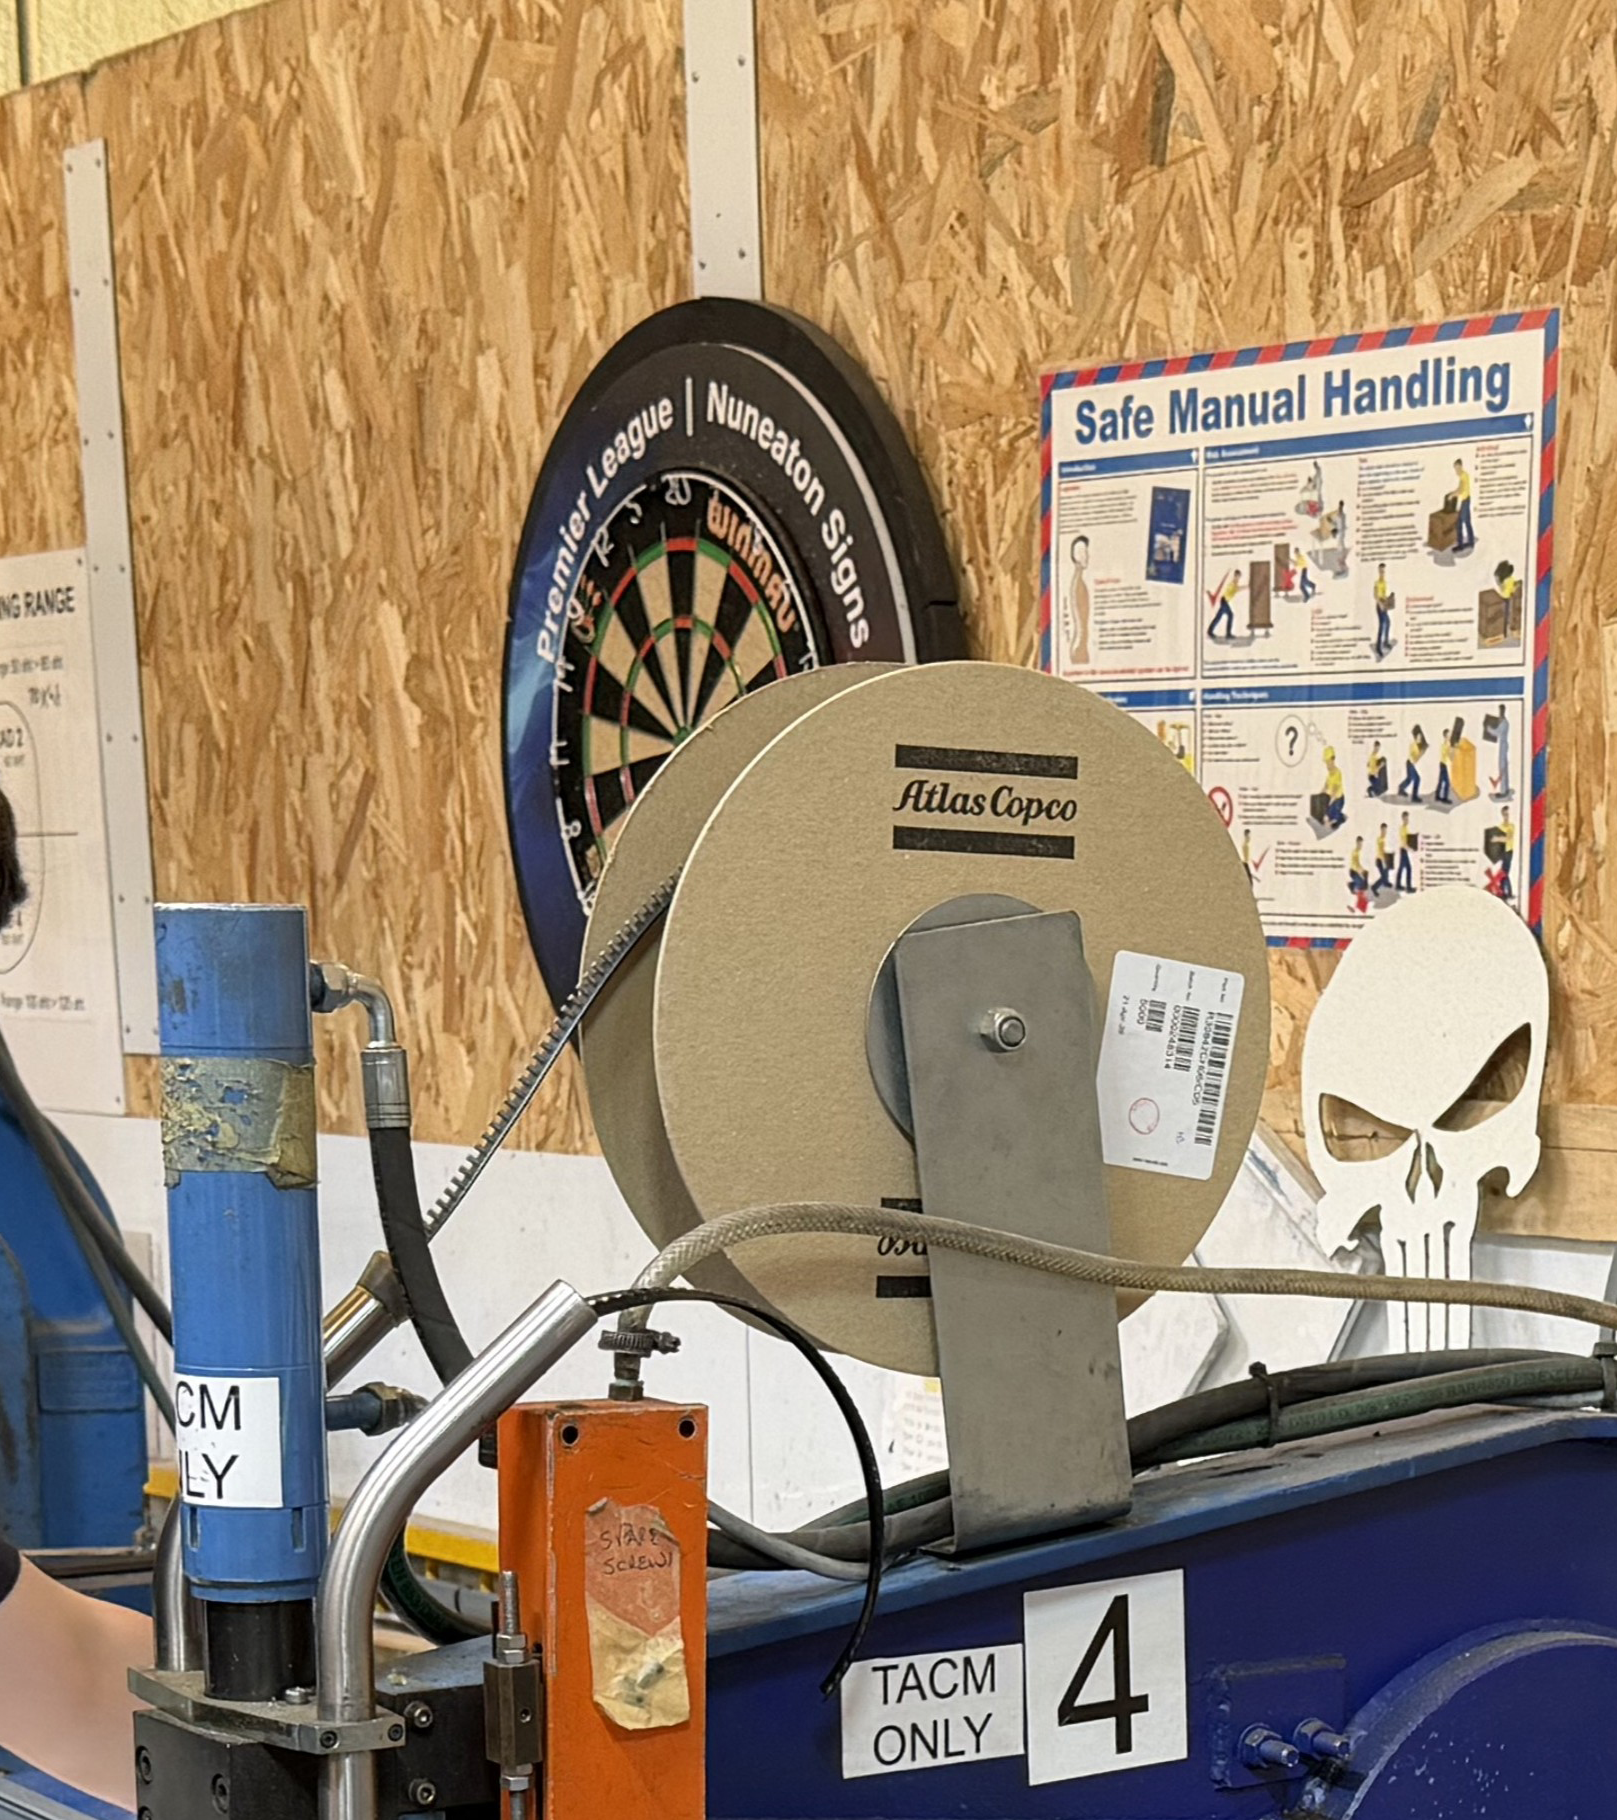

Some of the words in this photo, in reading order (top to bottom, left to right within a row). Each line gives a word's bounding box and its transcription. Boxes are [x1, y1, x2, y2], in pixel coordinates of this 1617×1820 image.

[1074, 395, 1155, 446] Safe
[1167, 374, 1307, 434] Manual
[1323, 356, 1512, 418] Handling
[537, 492, 591, 662] Premier
[587, 396, 674, 500] League
[706, 381, 826, 518] Nuneaton
[819, 506, 872, 650] Signs
[23, 586, 75, 617] RANGE
[893, 779, 987, 817] Atlas
[990, 785, 1078, 827] Copco
[871, 1653, 997, 1705] TACM
[1058, 1594, 1149, 1755] 4
[873, 1712, 993, 1767] ONLY
